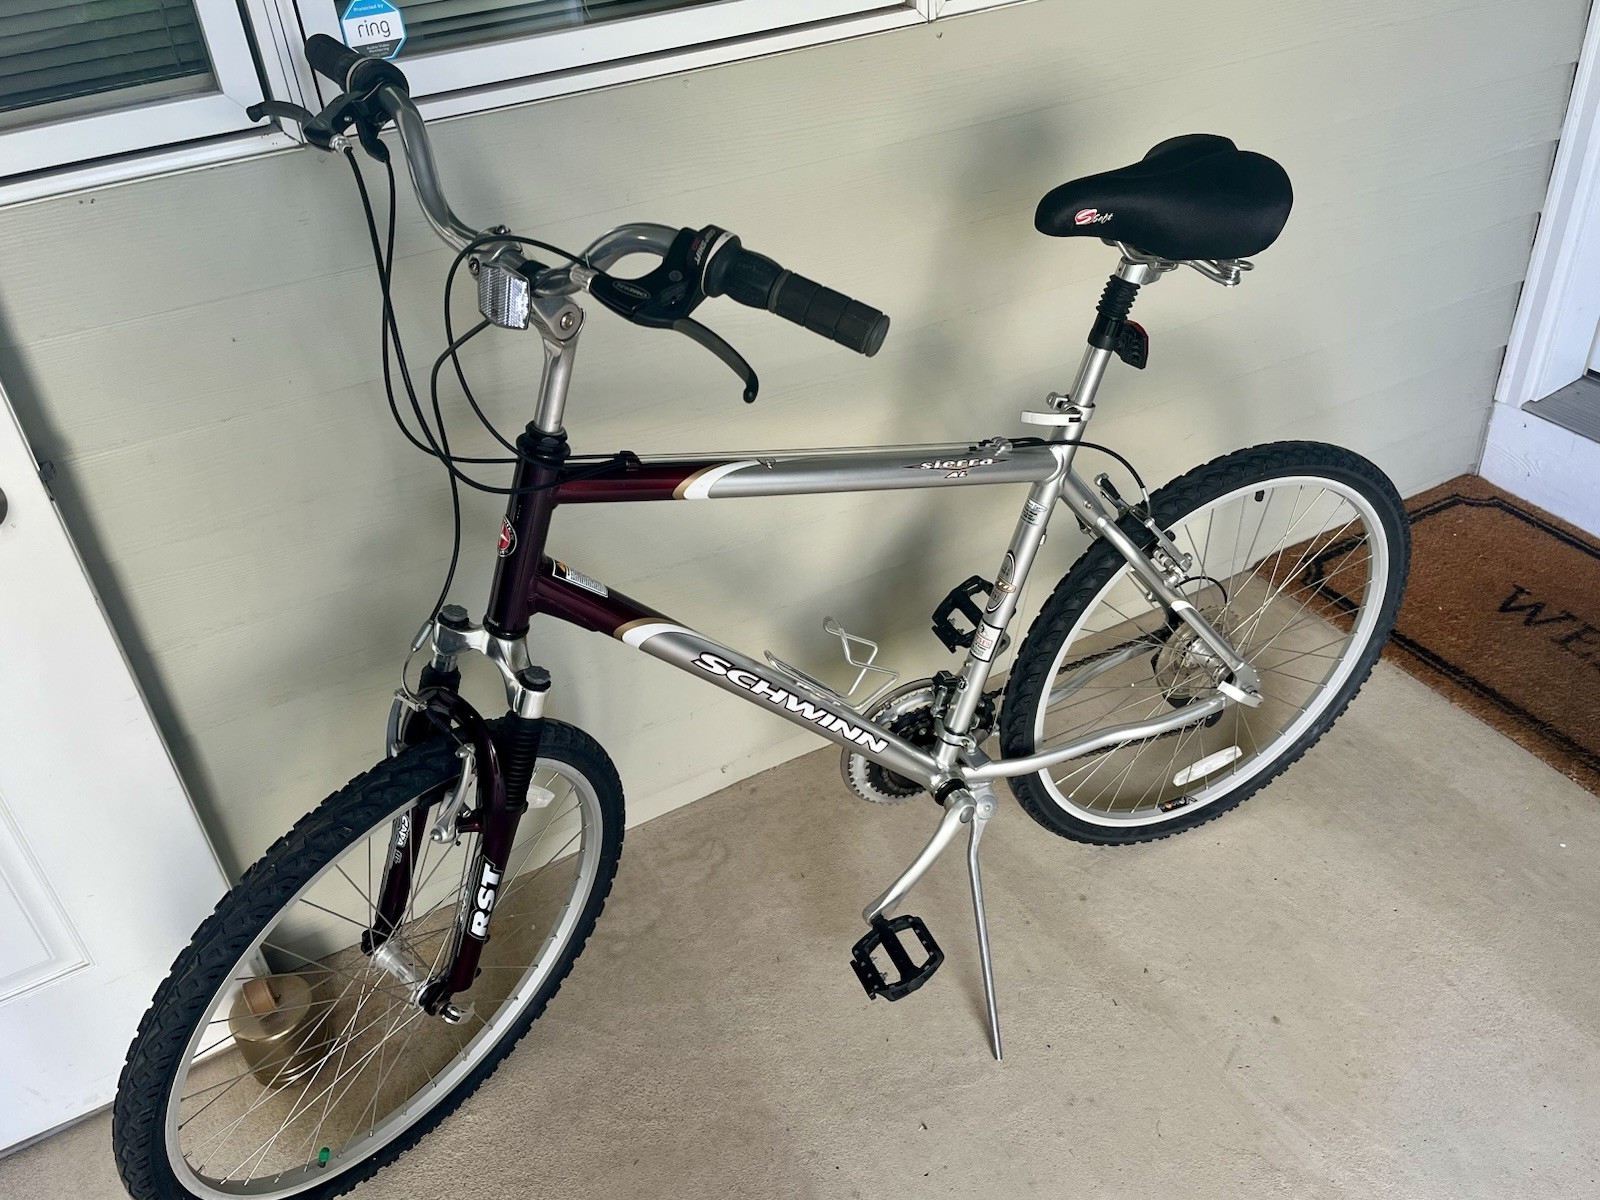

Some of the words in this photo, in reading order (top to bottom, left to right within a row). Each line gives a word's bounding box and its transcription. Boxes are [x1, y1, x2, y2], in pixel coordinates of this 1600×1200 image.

[357, 20, 391, 38] ring
[1497, 583, 1600, 675] WE
[691, 651, 889, 754] SCHWINN
[397, 815, 410, 847] CAPA
[471, 862, 500, 937] RST
